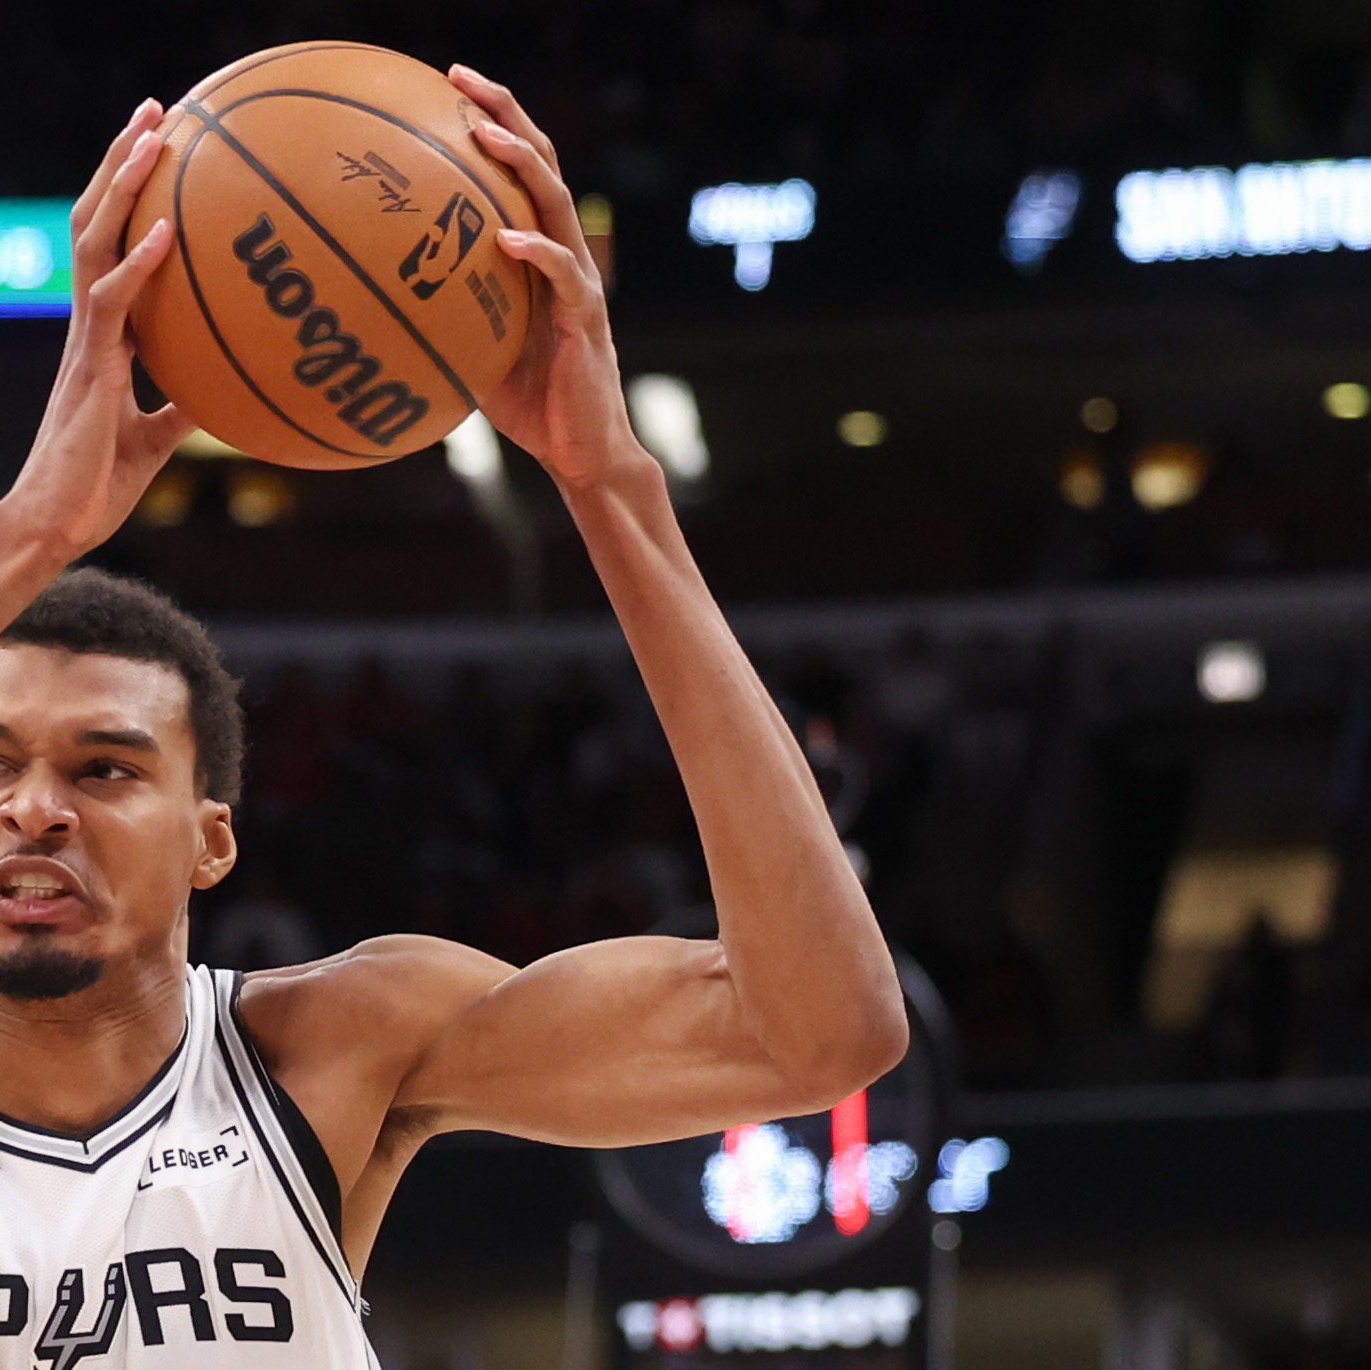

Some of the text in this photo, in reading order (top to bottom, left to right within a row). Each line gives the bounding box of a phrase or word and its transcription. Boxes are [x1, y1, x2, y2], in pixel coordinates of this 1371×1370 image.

[232, 211, 429, 447] Wilson
[148, 1143, 230, 1174] LEDGER
[698, 1286, 921, 1352] TISSOT
